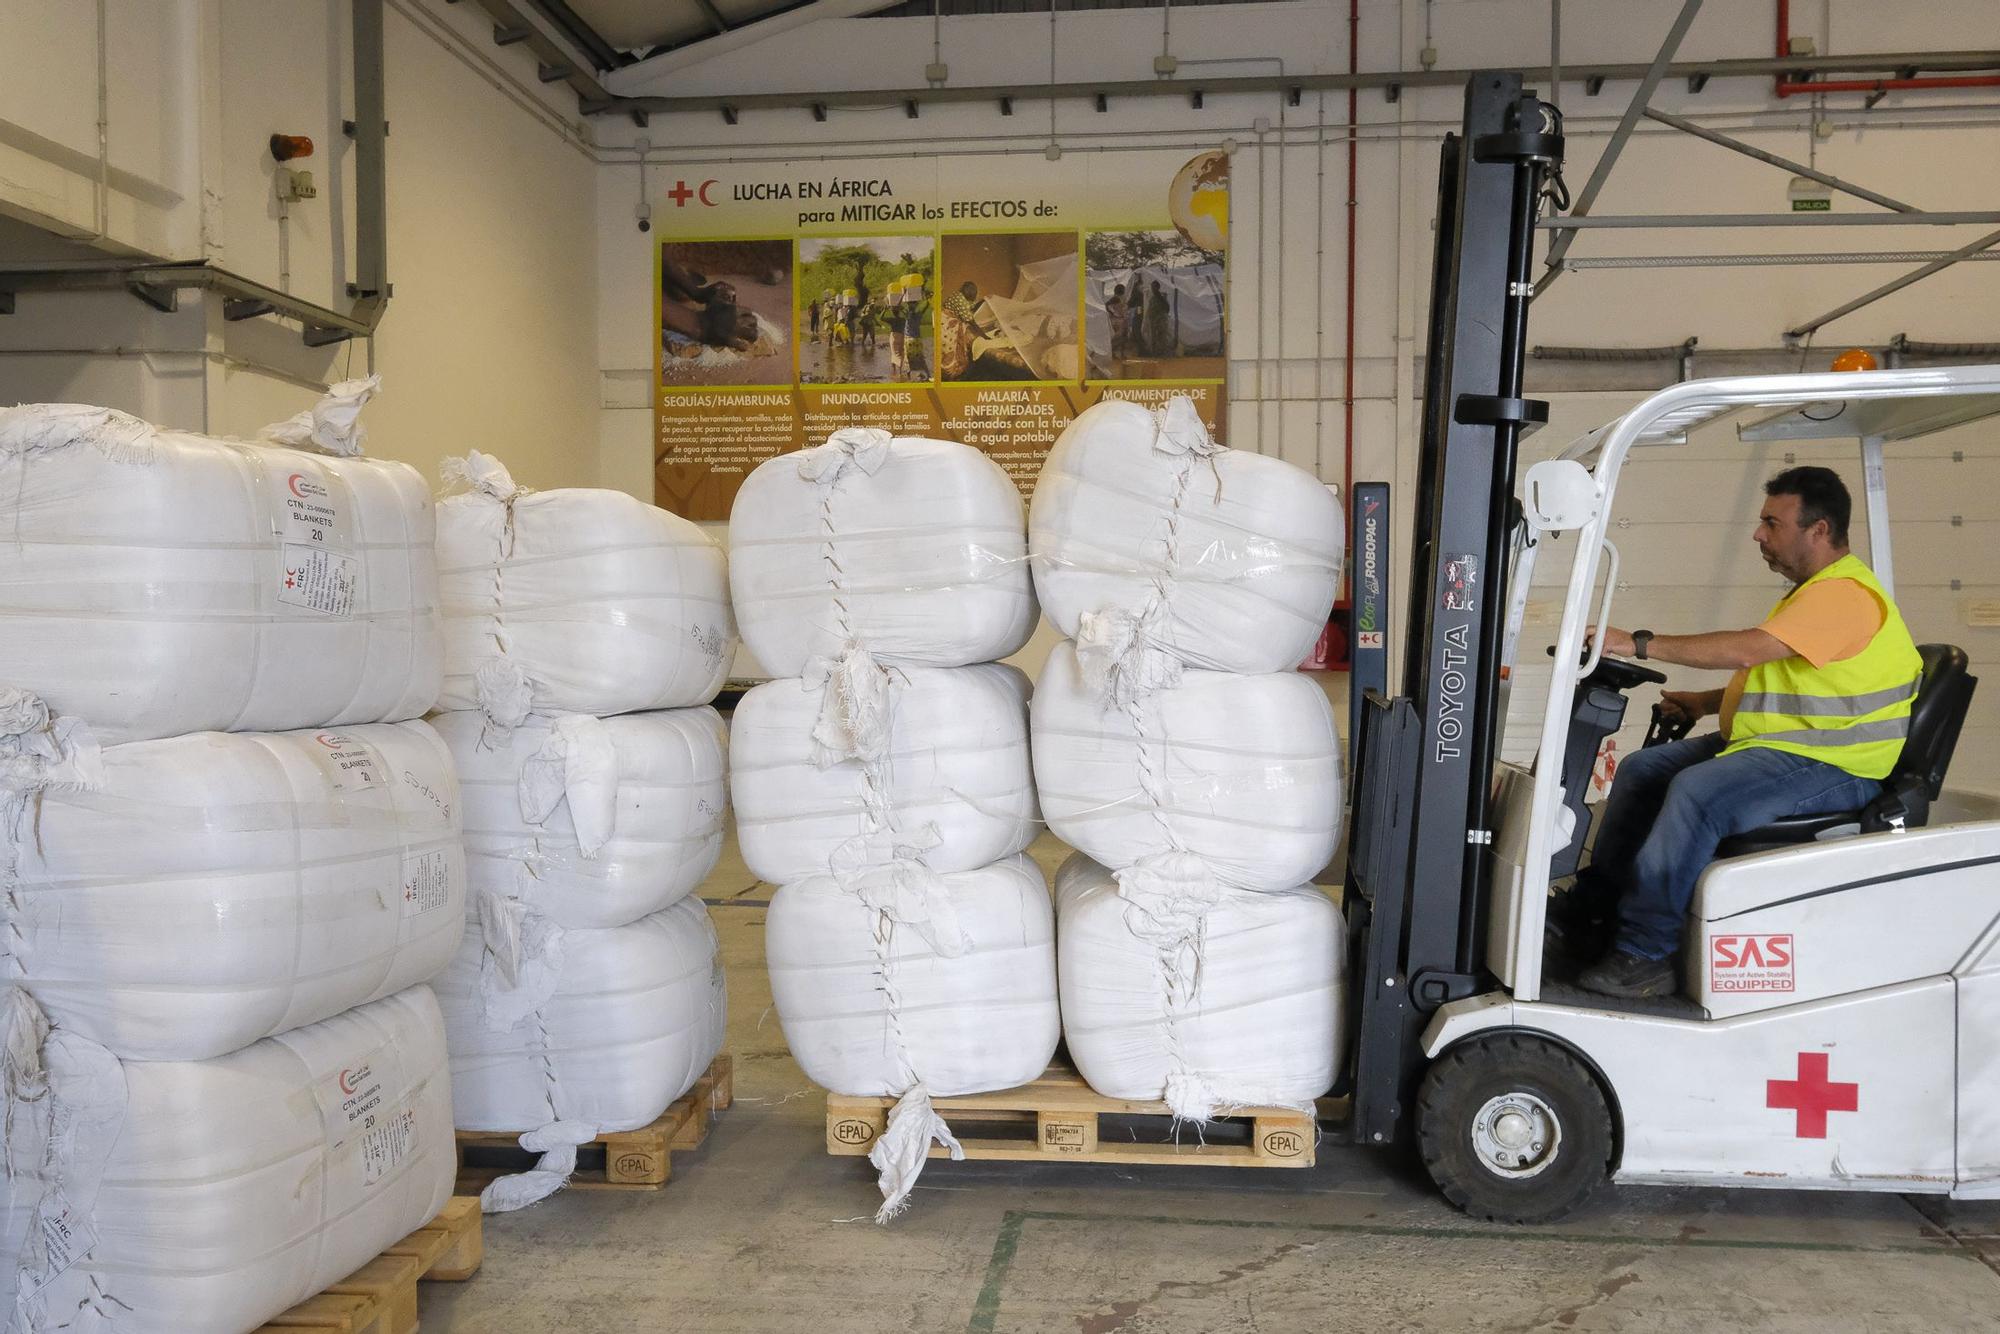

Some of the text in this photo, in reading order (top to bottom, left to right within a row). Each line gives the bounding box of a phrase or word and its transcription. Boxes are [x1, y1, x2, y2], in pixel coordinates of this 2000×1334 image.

[733, 177, 893, 200] LUCHA EN ÁFRICA
[1795, 201, 1829, 210] SALIDA
[798, 199, 1058, 228] para MITIGAR los EFECTOS de:
[663, 393, 791, 408] SEQUÍAS/HAMBRUNAS
[821, 392, 912, 405] INUNDACIONES
[977, 391, 1041, 402] MALARIA Y
[1102, 388, 1208, 401] MOVIMIENTOS DE
[804, 412, 850, 423] Distribuyendo
[851, 412, 861, 421] los
[891, 412, 901, 421] de
[902, 411, 929, 422] primera
[964, 404, 1055, 416] ENFERMEDADES
[661, 415, 699, 425] Entregando
[775, 413, 793, 422] redes
[941, 415, 1072, 430] relacionadas con la falt
[661, 424, 671, 433] de
[704, 427, 721, 435] para
[721, 426, 753, 434] recuperar
[754, 424, 762, 432] la
[762, 423, 793, 432] actividad
[802, 422, 836, 431] necesidad
[736, 434, 743, 442] el
[743, 433, 793, 442] abastecimiento
[963, 430, 1055, 446] de agua potable
[673, 444, 682, 453] de
[683, 447, 700, 455] agua
[701, 446, 717, 455] para
[748, 443, 776, 453] humano
[776, 445, 782, 454] y
[293, 511, 333, 528] BLANKETS
[311, 528, 323, 542] 20
[1364, 517, 1378, 578] ROBOPAC
[1435, 623, 1470, 764] TOYOTA
[340, 759, 372, 770] BLANKETS
[1714, 936, 1791, 969] SAS
[1714, 979, 1792, 990] EQUIPPED
[348, 1095, 382, 1122] BLANKETS
[364, 1114, 376, 1129] 20
[839, 1124, 868, 1140] EPAL
[1269, 1135, 1300, 1151] EPAL
